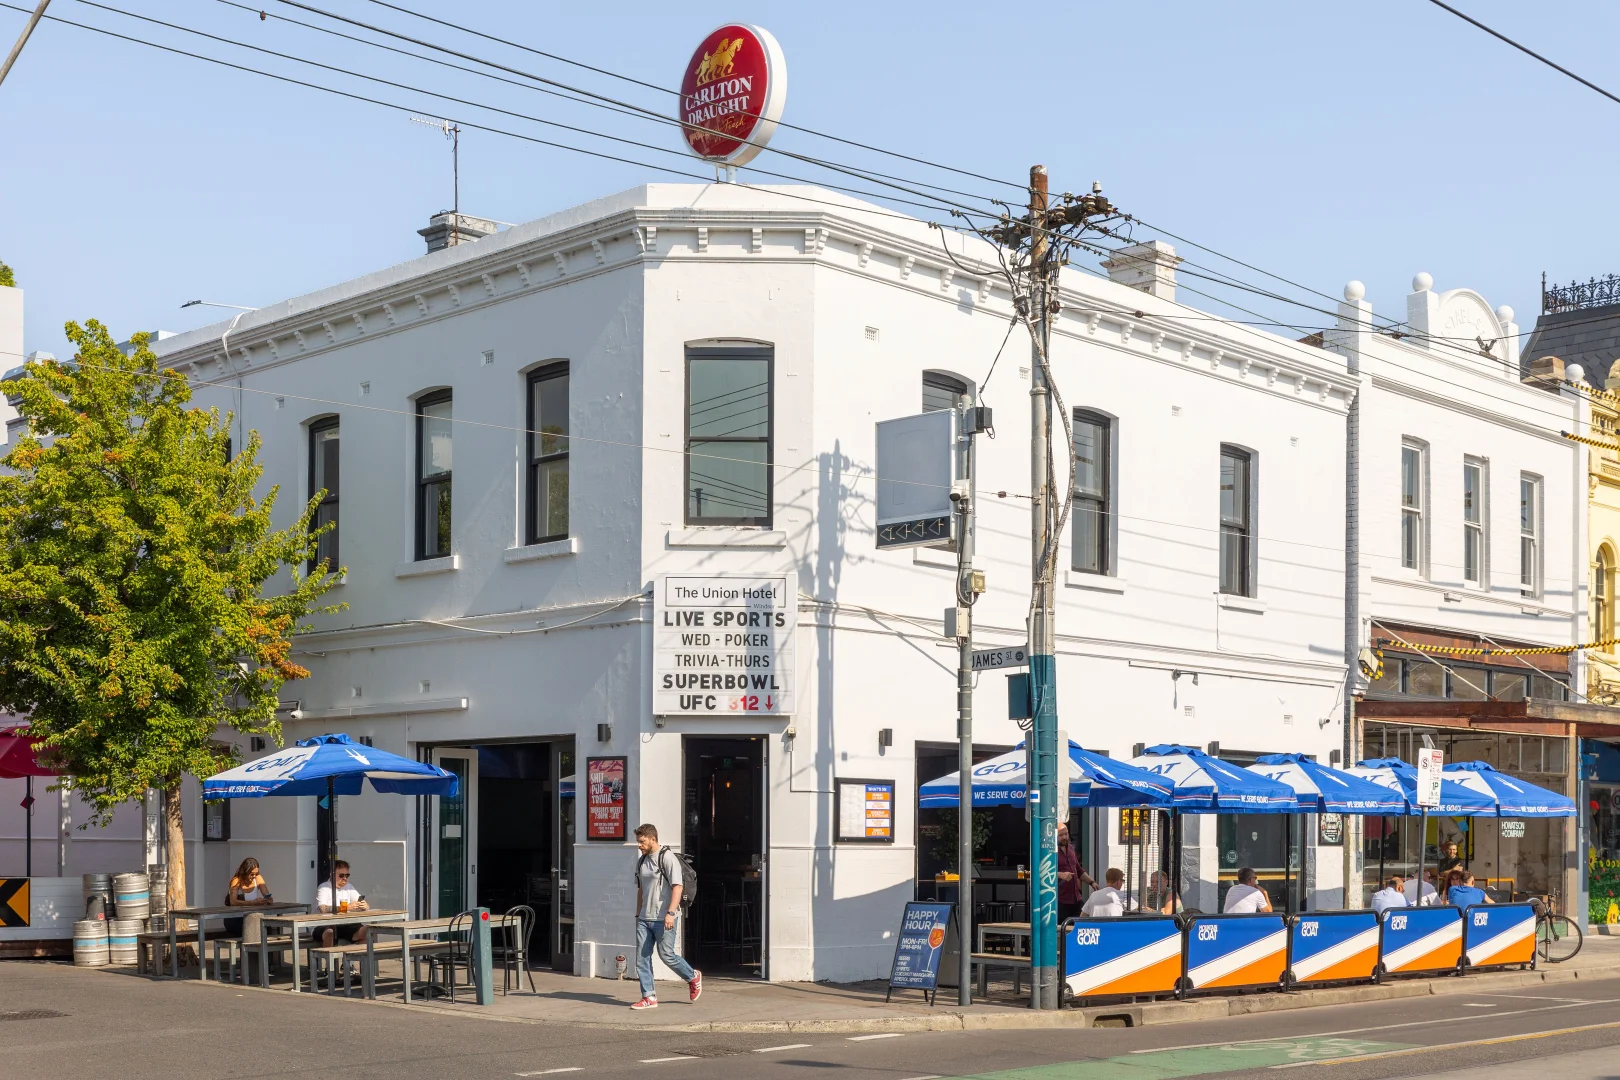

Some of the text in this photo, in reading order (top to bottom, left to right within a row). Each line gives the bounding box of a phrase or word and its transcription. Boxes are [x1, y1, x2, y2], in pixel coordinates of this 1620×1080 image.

[686, 76, 753, 110] CARLTON
[688, 96, 750, 124] DRAUGHT
[674, 587, 776, 599] The Union Hotel
[664, 611, 785, 627] LIVE SPORTS
[682, 634, 710, 646] WED
[725, 634, 768, 646] POKER
[675, 654, 770, 667] TRIVIA-THURS
[972, 652, 1002, 668] JAMES
[1006, 651, 1012, 660] ST
[663, 674, 779, 690] SUPERBOWL
[680, 695, 759, 710] UFC 312
[245, 754, 306, 772] GOAT
[974, 762, 1026, 776] GO
[591, 773, 604, 784] SHIT
[592, 783, 604, 794] PUB
[1432, 782, 1438, 790] 1P
[592, 794, 612, 804] TRIVIA
[987, 791, 1008, 799] SERVE
[907, 911, 939, 920] HAPPY
[905, 921, 931, 930] HOUR
[1391, 921, 1407, 930] GOAT
[1474, 918, 1488, 926] GOAT
[1198, 930, 1217, 940] GOAT
[1302, 927, 1318, 936] GOAT
[1077, 935, 1099, 945] GOAT
